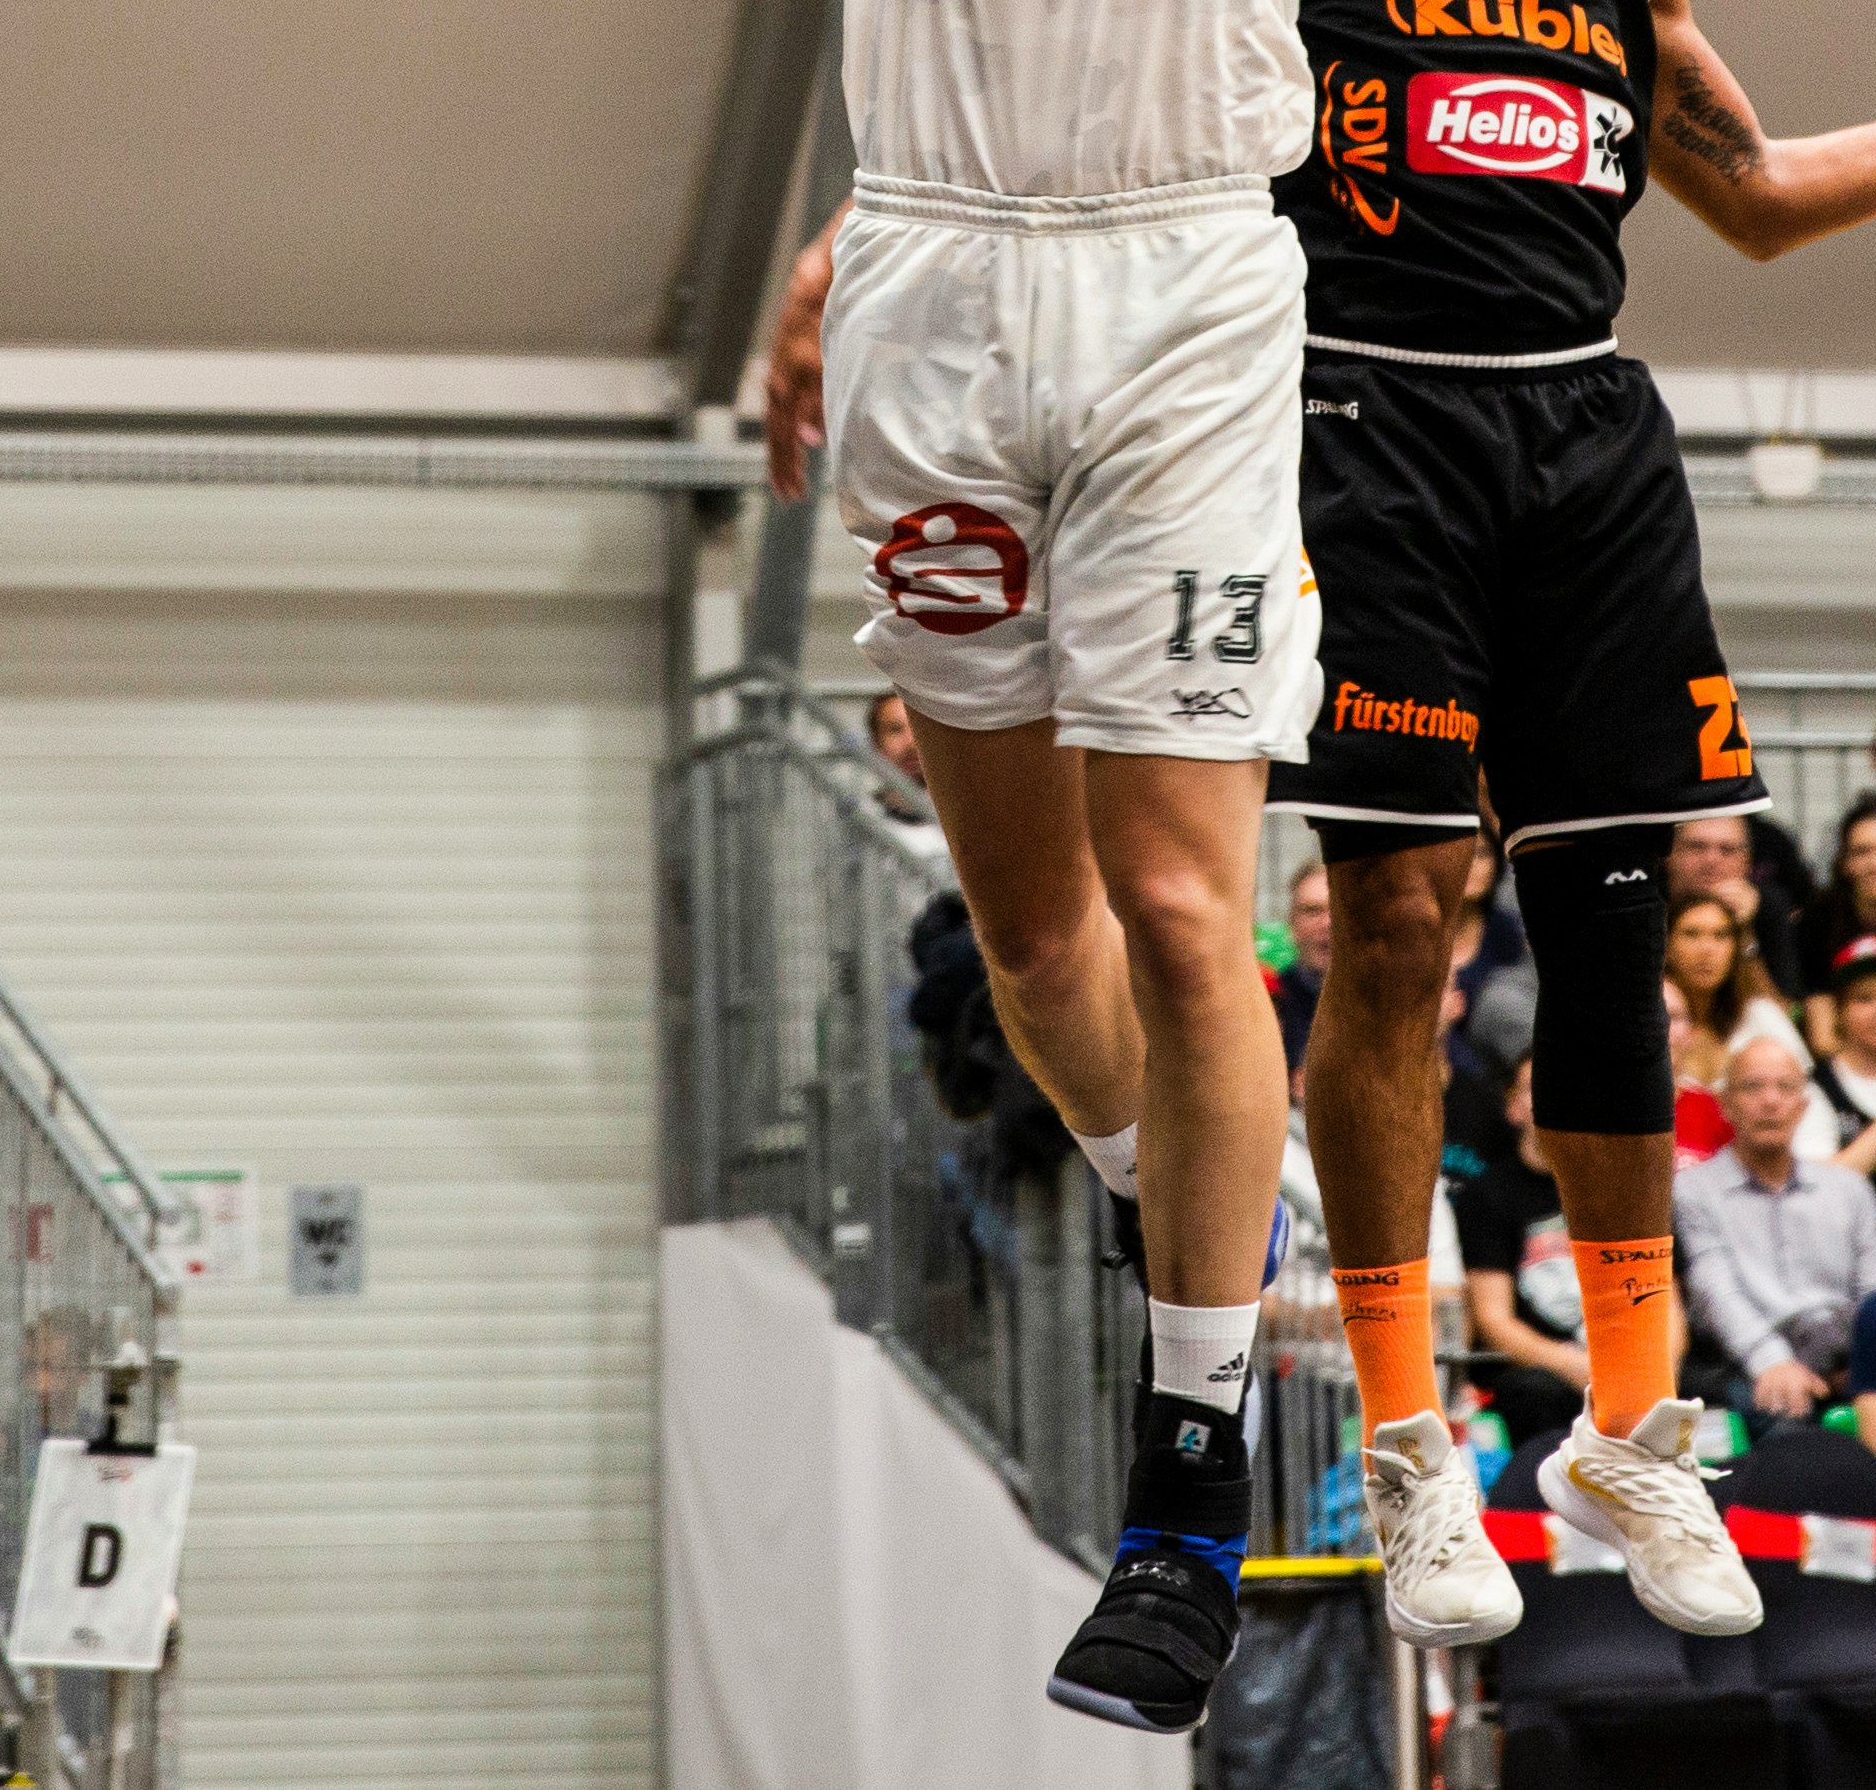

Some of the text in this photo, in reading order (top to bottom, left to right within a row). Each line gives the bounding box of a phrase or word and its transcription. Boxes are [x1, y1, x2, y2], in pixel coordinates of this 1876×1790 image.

[1342, 78, 1388, 175] SDV
[1427, 98, 1580, 153] Helios
[1165, 569, 1270, 665] 13
[78, 1523, 124, 1589] D
